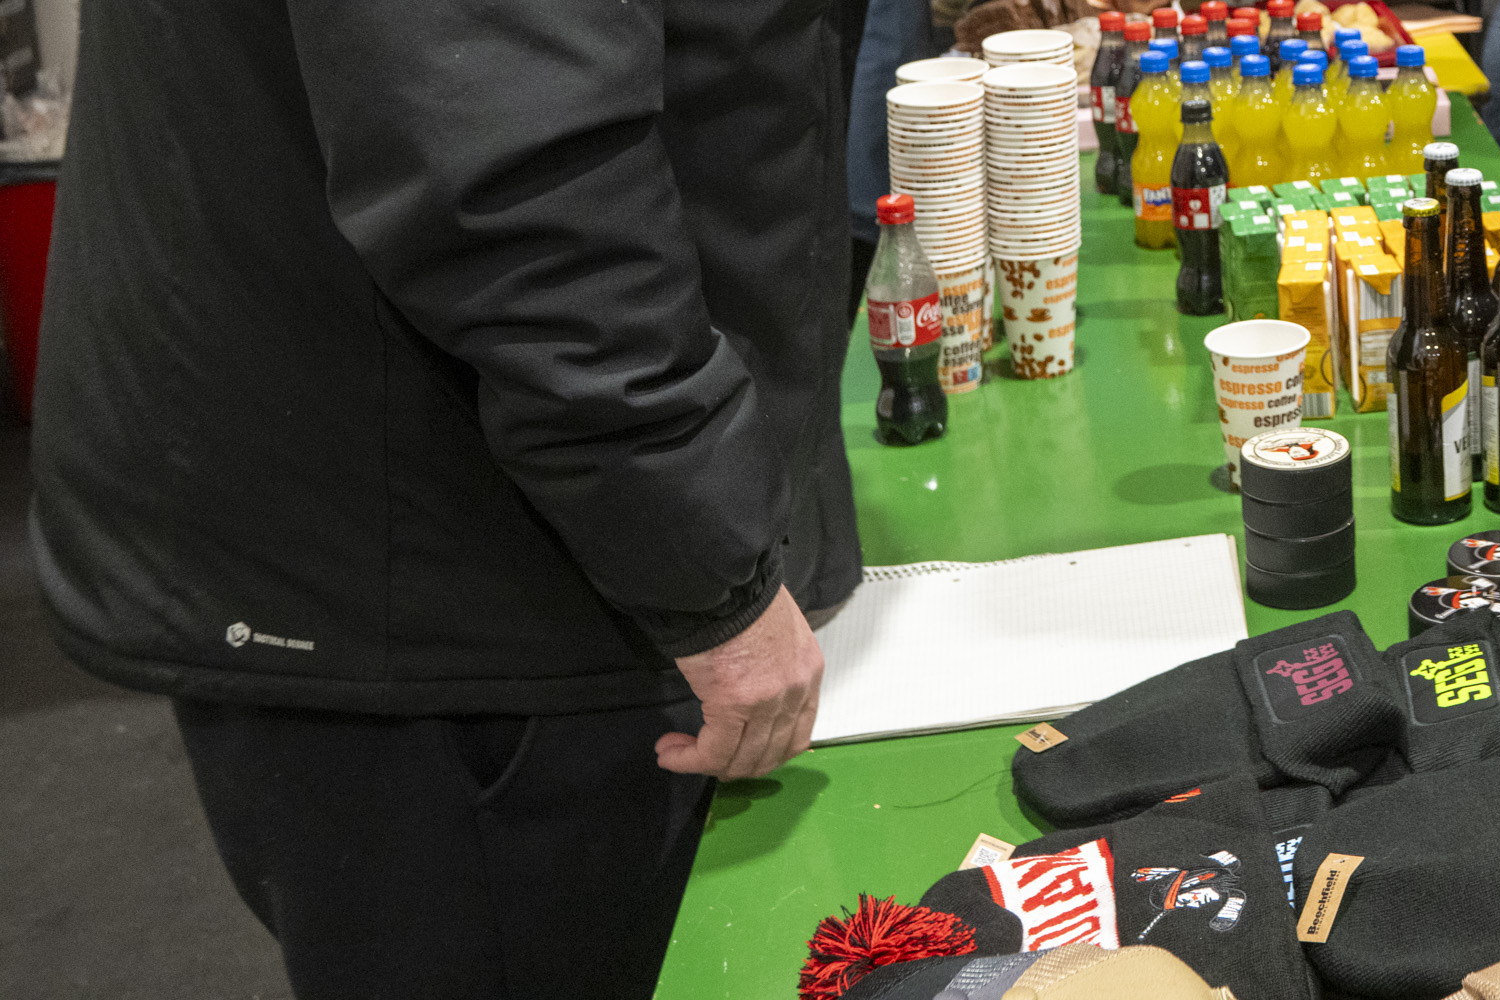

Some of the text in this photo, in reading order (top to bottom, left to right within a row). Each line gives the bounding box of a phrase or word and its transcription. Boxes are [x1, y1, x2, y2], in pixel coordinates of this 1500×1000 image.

[1231, 363, 1280, 374] espresso
[1219, 378, 1282, 396] espresso
[1307, 869, 1338, 935] Beechfield
